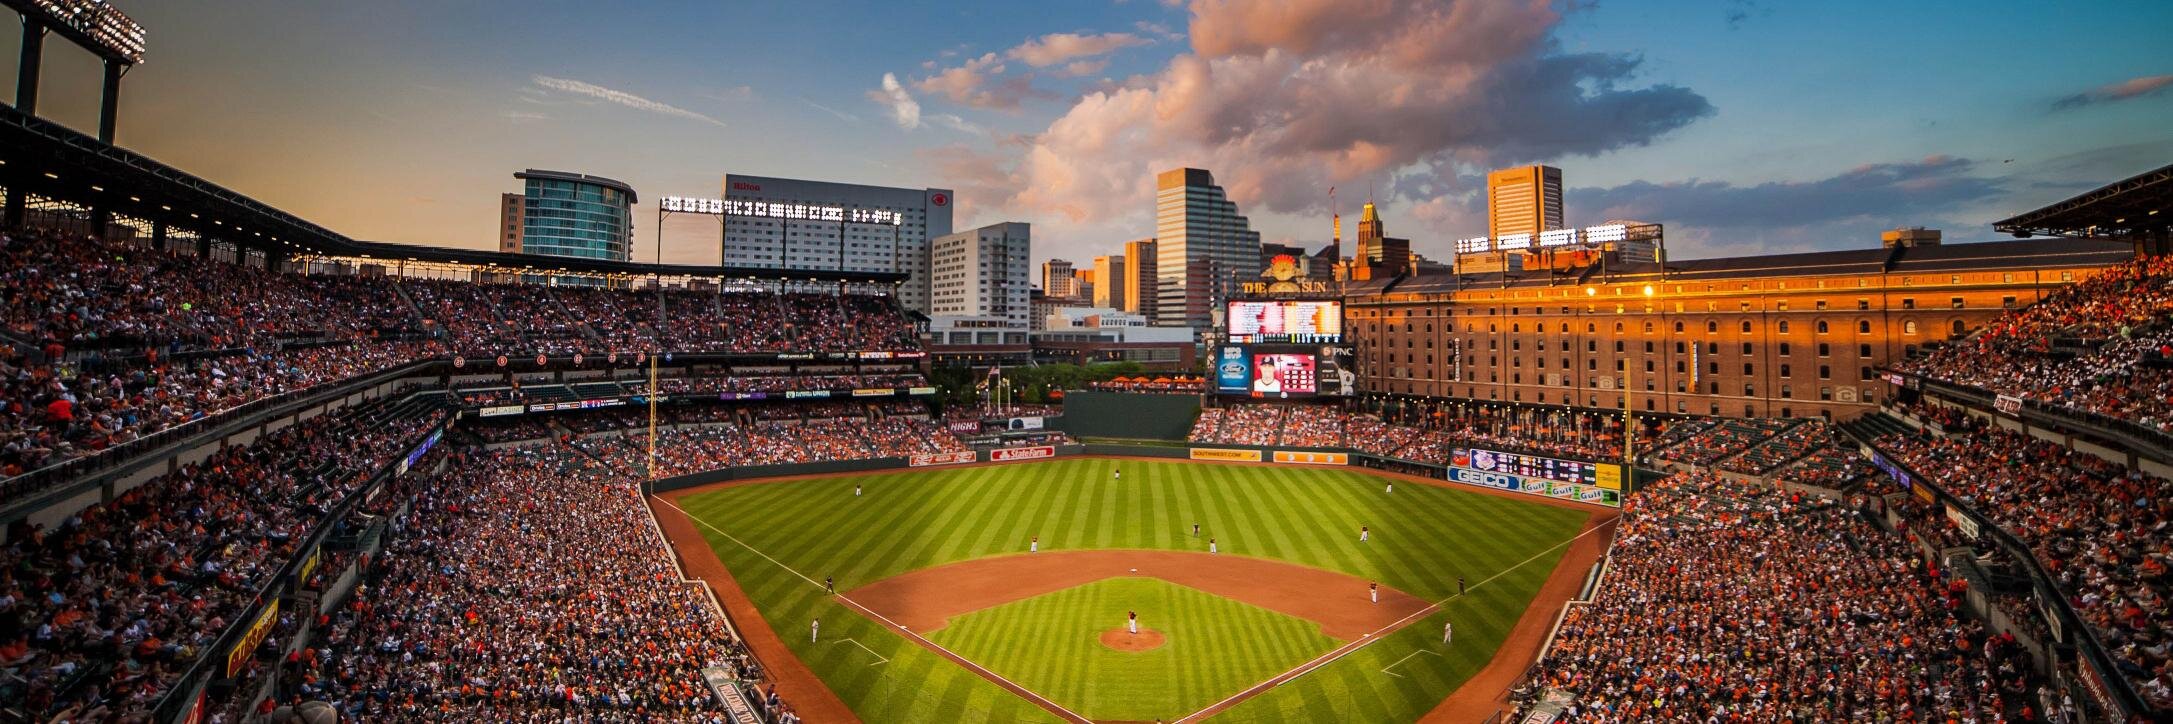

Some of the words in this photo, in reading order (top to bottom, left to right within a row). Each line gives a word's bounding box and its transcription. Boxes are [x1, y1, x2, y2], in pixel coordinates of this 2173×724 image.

[734, 182, 760, 191] Hilton
[1242, 282, 1266, 293] THE
[1302, 281, 1326, 292] SUN
[1333, 347, 1353, 356] PNC
[1458, 470, 1509, 488] GEICO
[1526, 481, 1545, 492] Gulf
[1553, 486, 1572, 496] Gulf
[1581, 490, 1601, 500] Gulf
